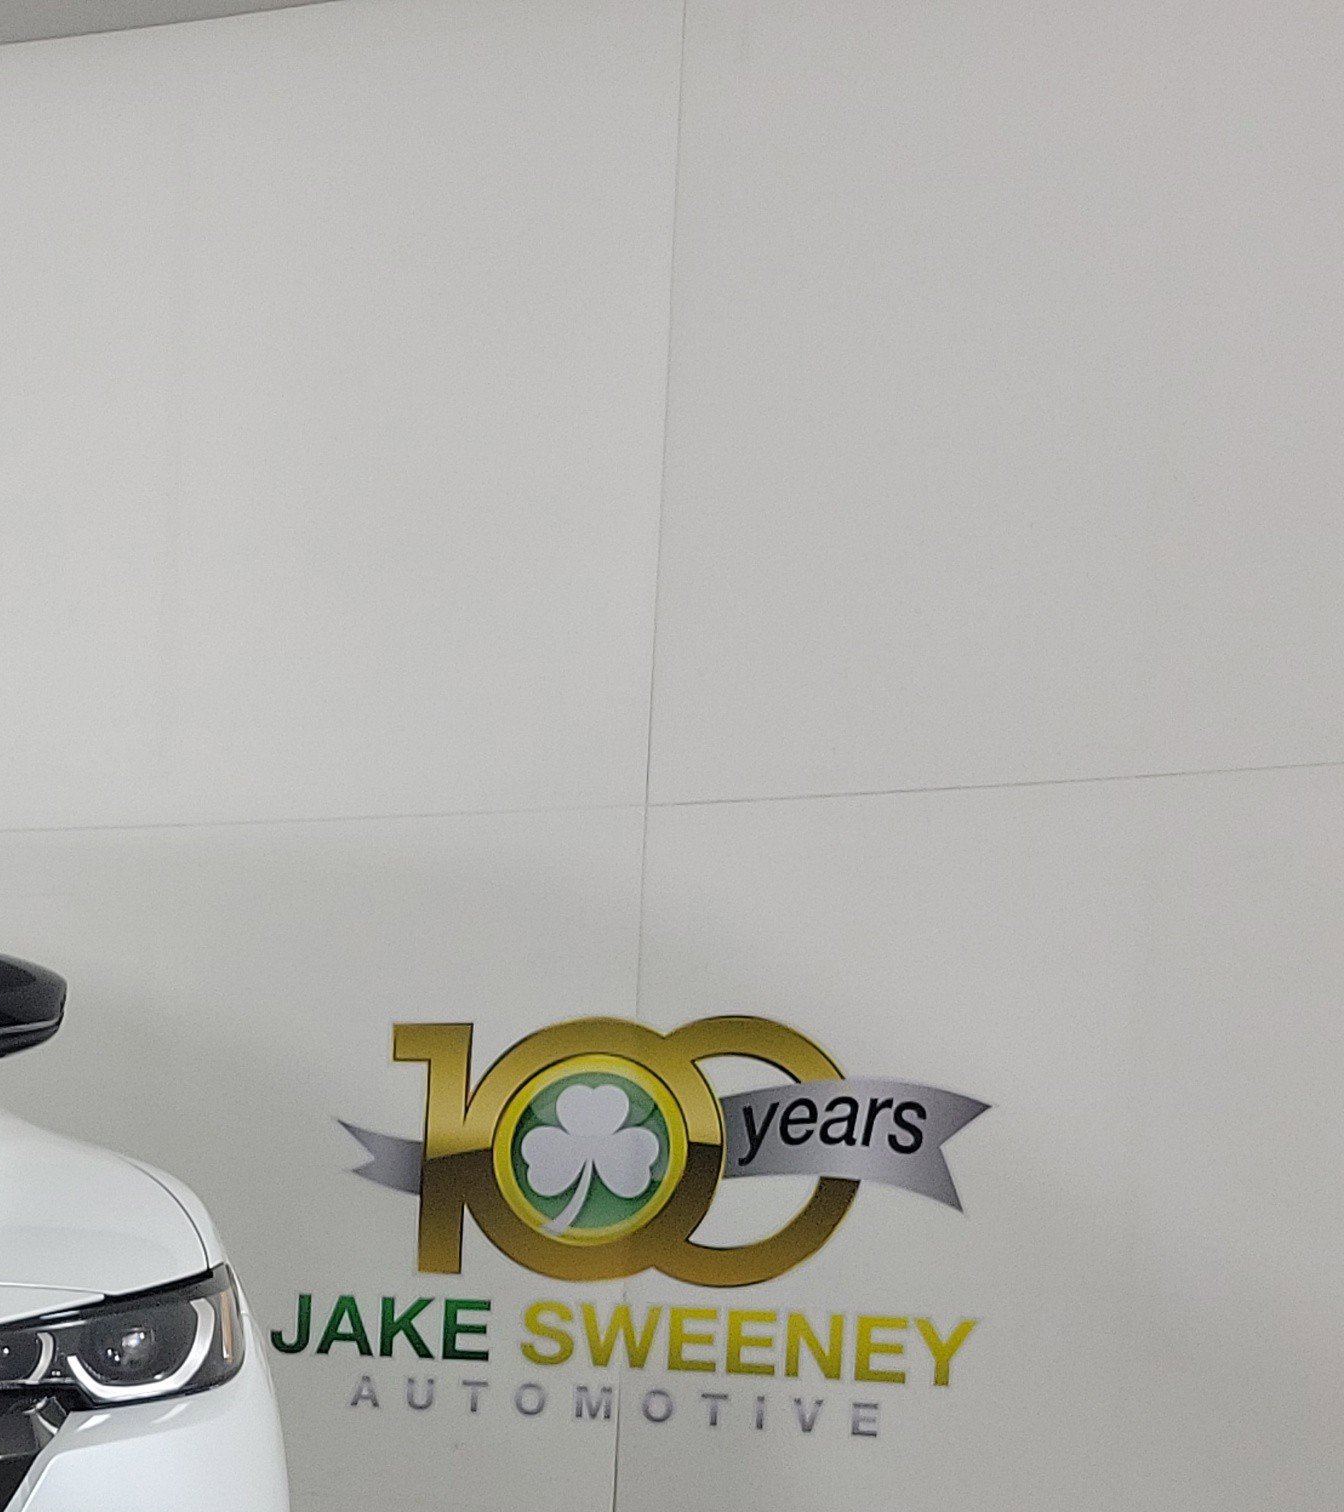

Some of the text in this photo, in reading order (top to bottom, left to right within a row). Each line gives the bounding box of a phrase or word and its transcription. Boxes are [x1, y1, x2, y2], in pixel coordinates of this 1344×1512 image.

[393, 1015, 858, 1287] 100
[738, 1095, 926, 1167] years
[270, 1294, 978, 1387] JAKE SWEENEY
[350, 1374, 879, 1437] AUTOMOTIVE
